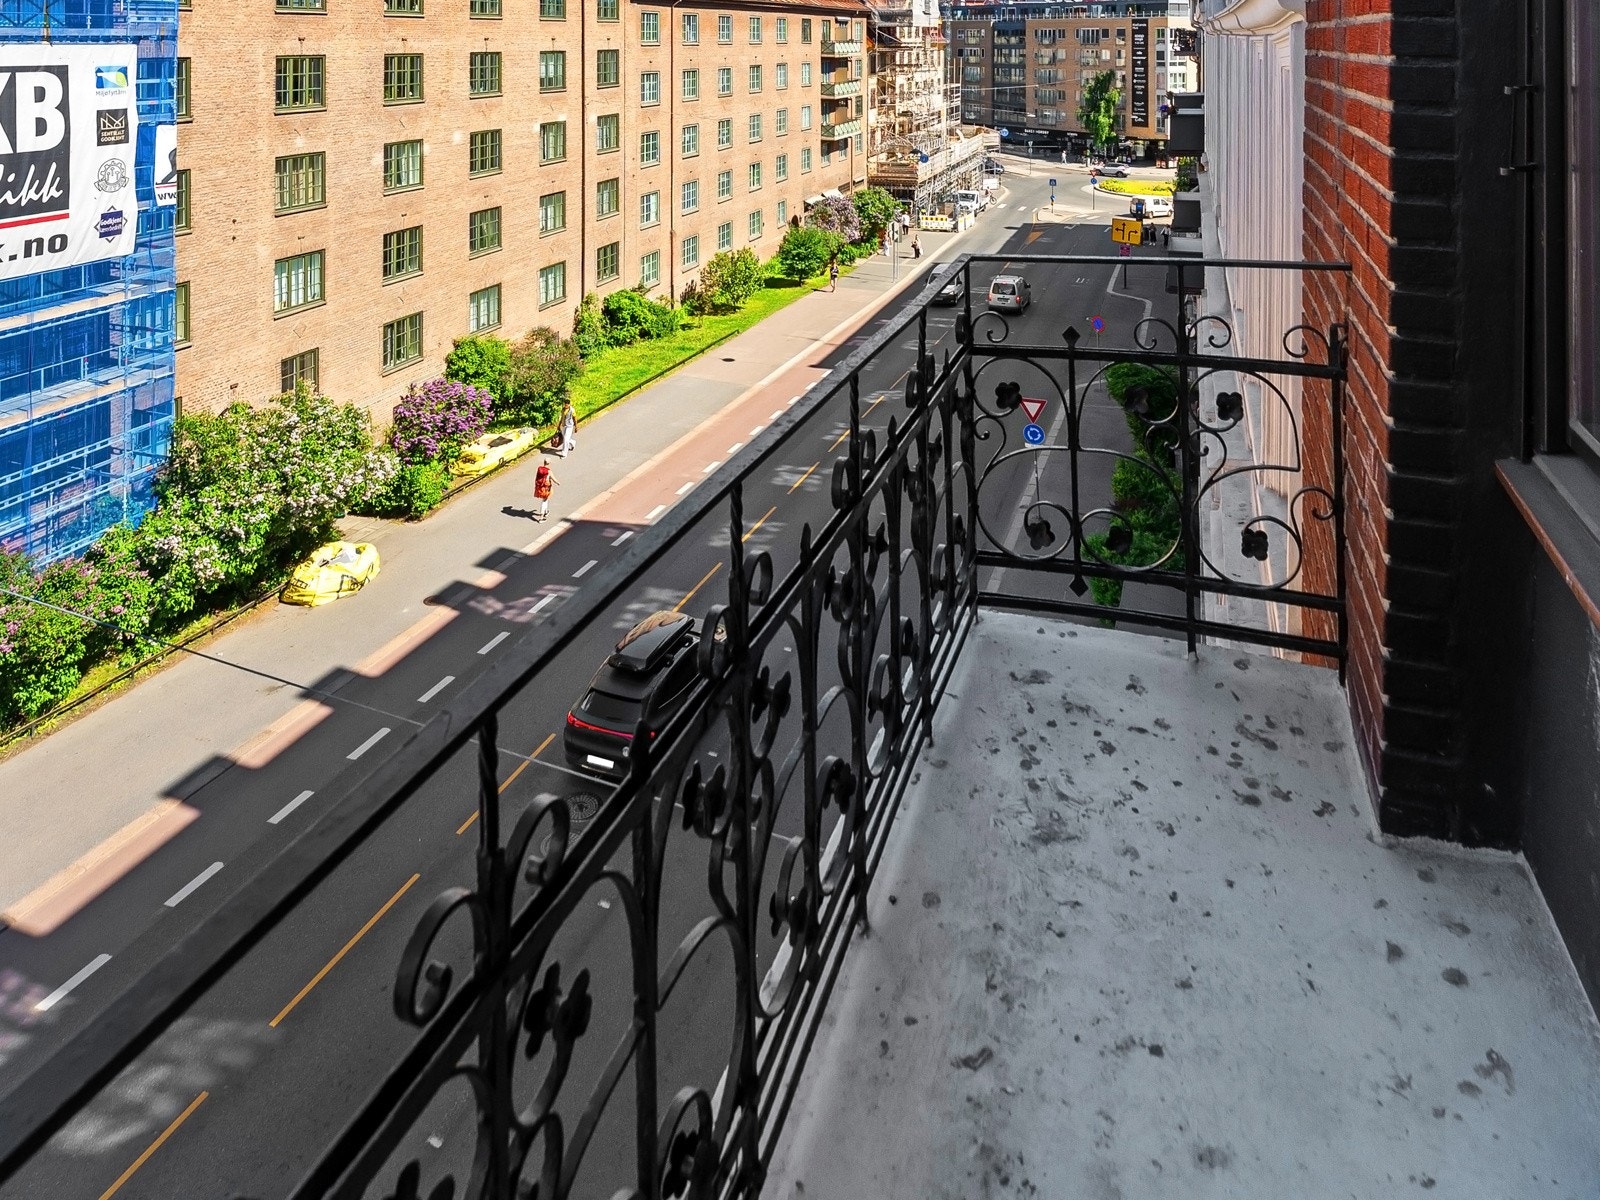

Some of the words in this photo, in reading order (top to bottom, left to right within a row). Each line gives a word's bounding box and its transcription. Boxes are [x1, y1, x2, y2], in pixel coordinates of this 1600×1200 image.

[0, 72, 65, 154] B
[0, 162, 63, 206] ikk
[100, 216, 122, 226] Godkjent
[0, 233, 68, 263] .no
